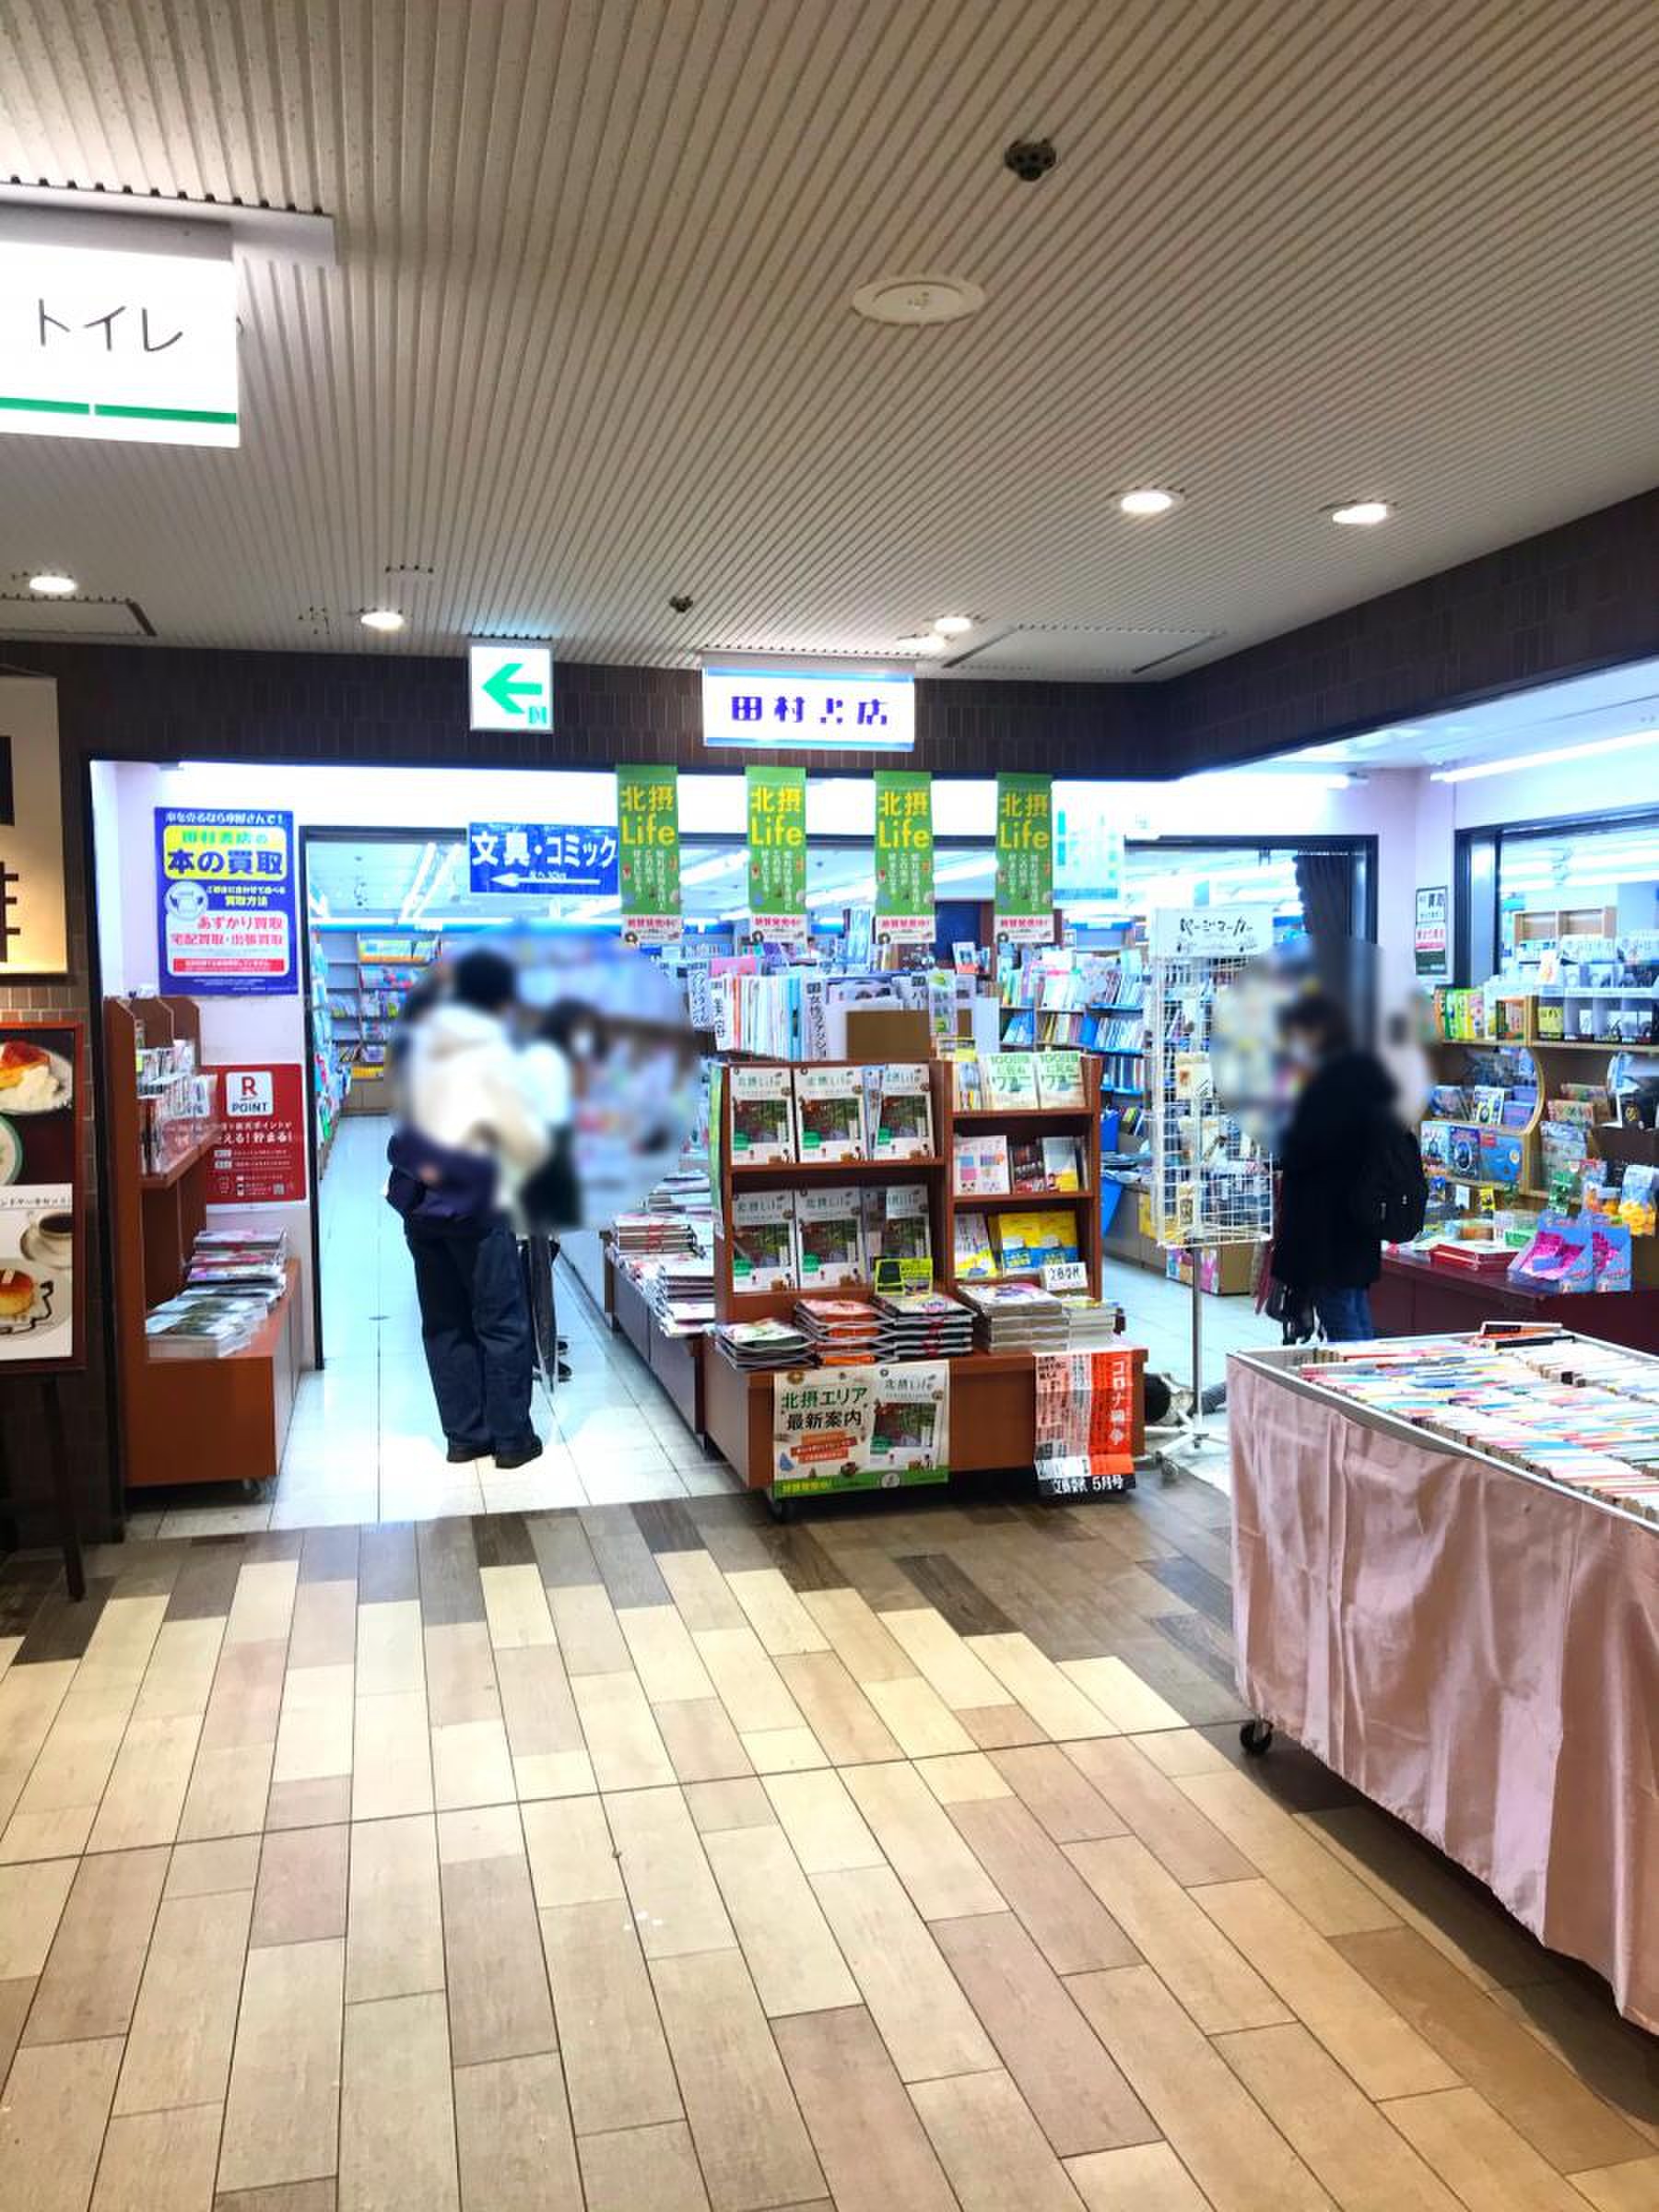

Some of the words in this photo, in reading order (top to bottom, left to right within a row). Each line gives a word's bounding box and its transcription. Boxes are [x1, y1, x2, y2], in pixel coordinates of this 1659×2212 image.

[39, 298, 183, 352] トイレ
[620, 784, 674, 812] 北摂
[750, 786, 802, 812] 北摂
[878, 791, 928, 816] 北摂
[1000, 793, 1049, 818] 北摂
[621, 813, 676, 845] Life
[751, 815, 803, 846] Life
[878, 819, 930, 848] Life
[1000, 820, 1050, 849] Life
[167, 848, 283, 875] 本の買取
[197, 915, 283, 930] あずかり買取
[241, 1077, 258, 1097] R
[232, 1102, 268, 1113] POINT
[781, 1387, 868, 1409] 北摂エリア
[787, 1410, 863, 1431] 最新案内
